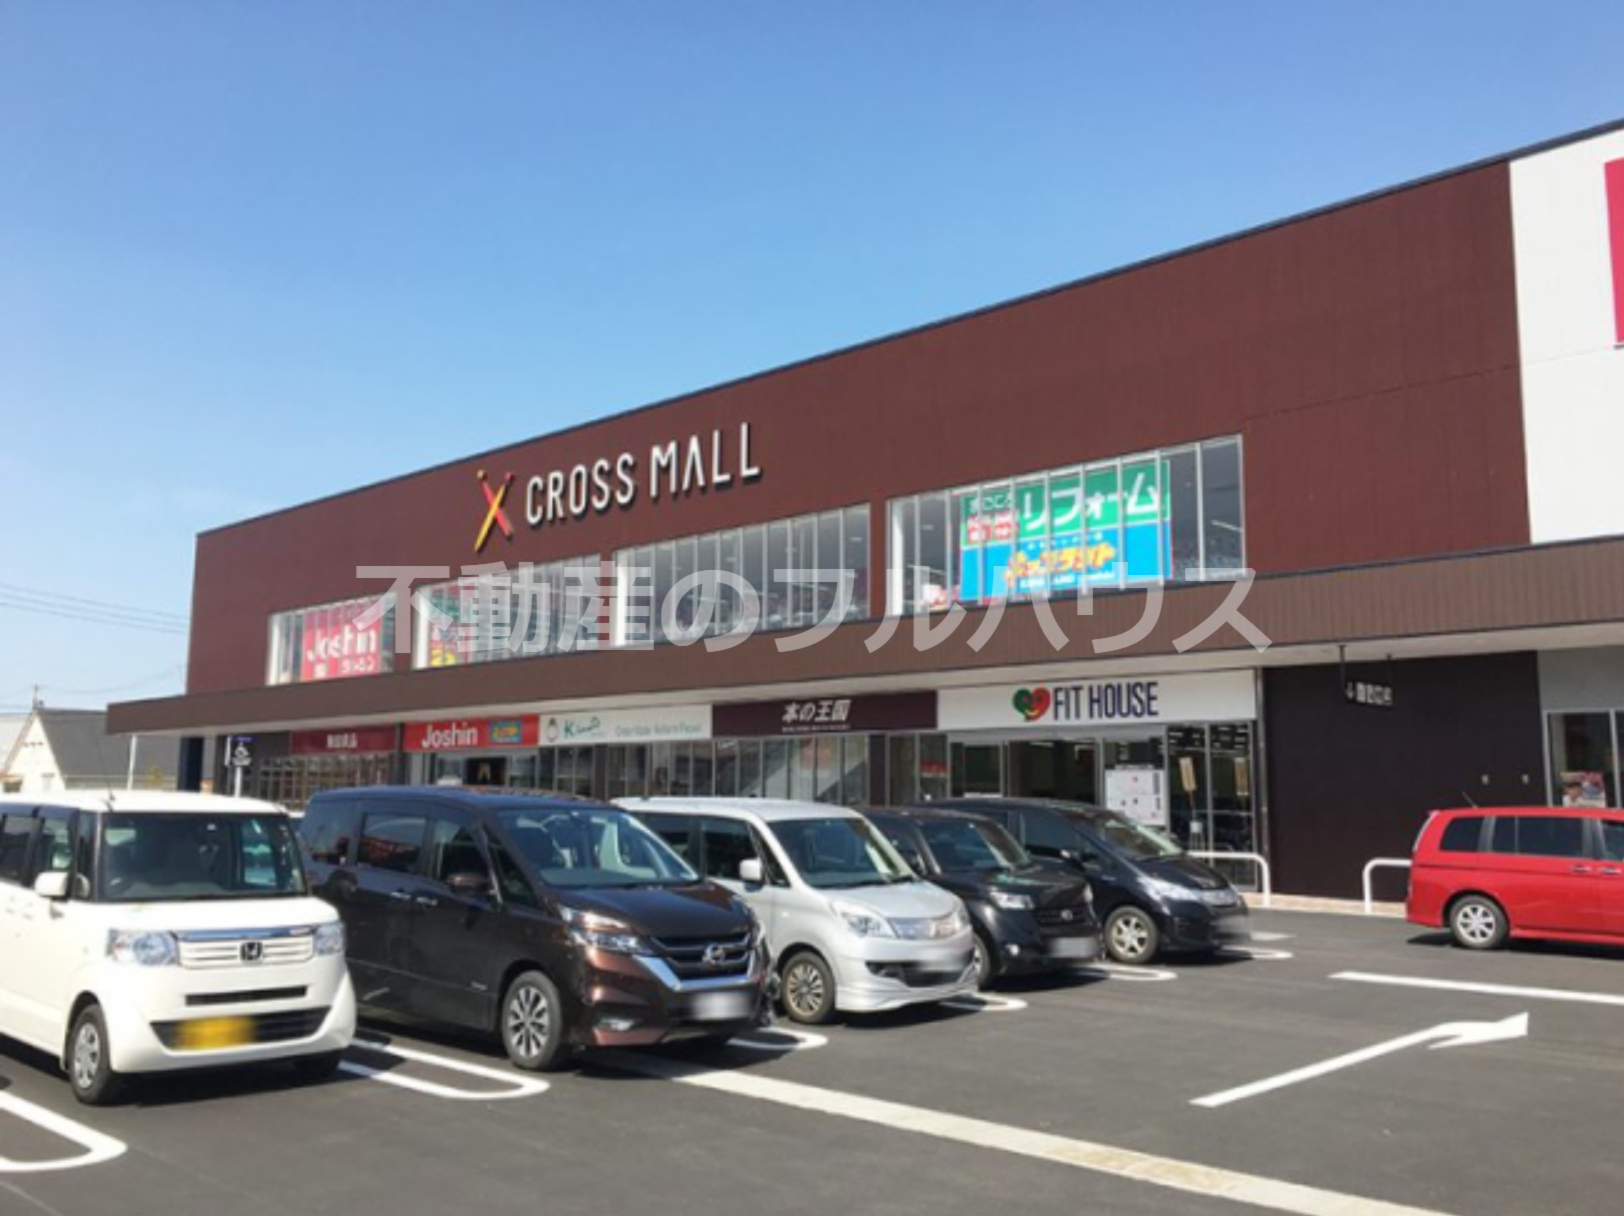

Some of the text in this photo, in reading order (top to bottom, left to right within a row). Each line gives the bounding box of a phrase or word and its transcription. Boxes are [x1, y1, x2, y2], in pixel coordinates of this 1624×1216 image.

[525, 421, 761, 525] CROSS MALL
[1020, 470, 1160, 532] リフォーム
[782, 699, 851, 723] 本の王国
[1053, 681, 1159, 721] FIT HOUSE
[421, 721, 478, 748] Joshin
